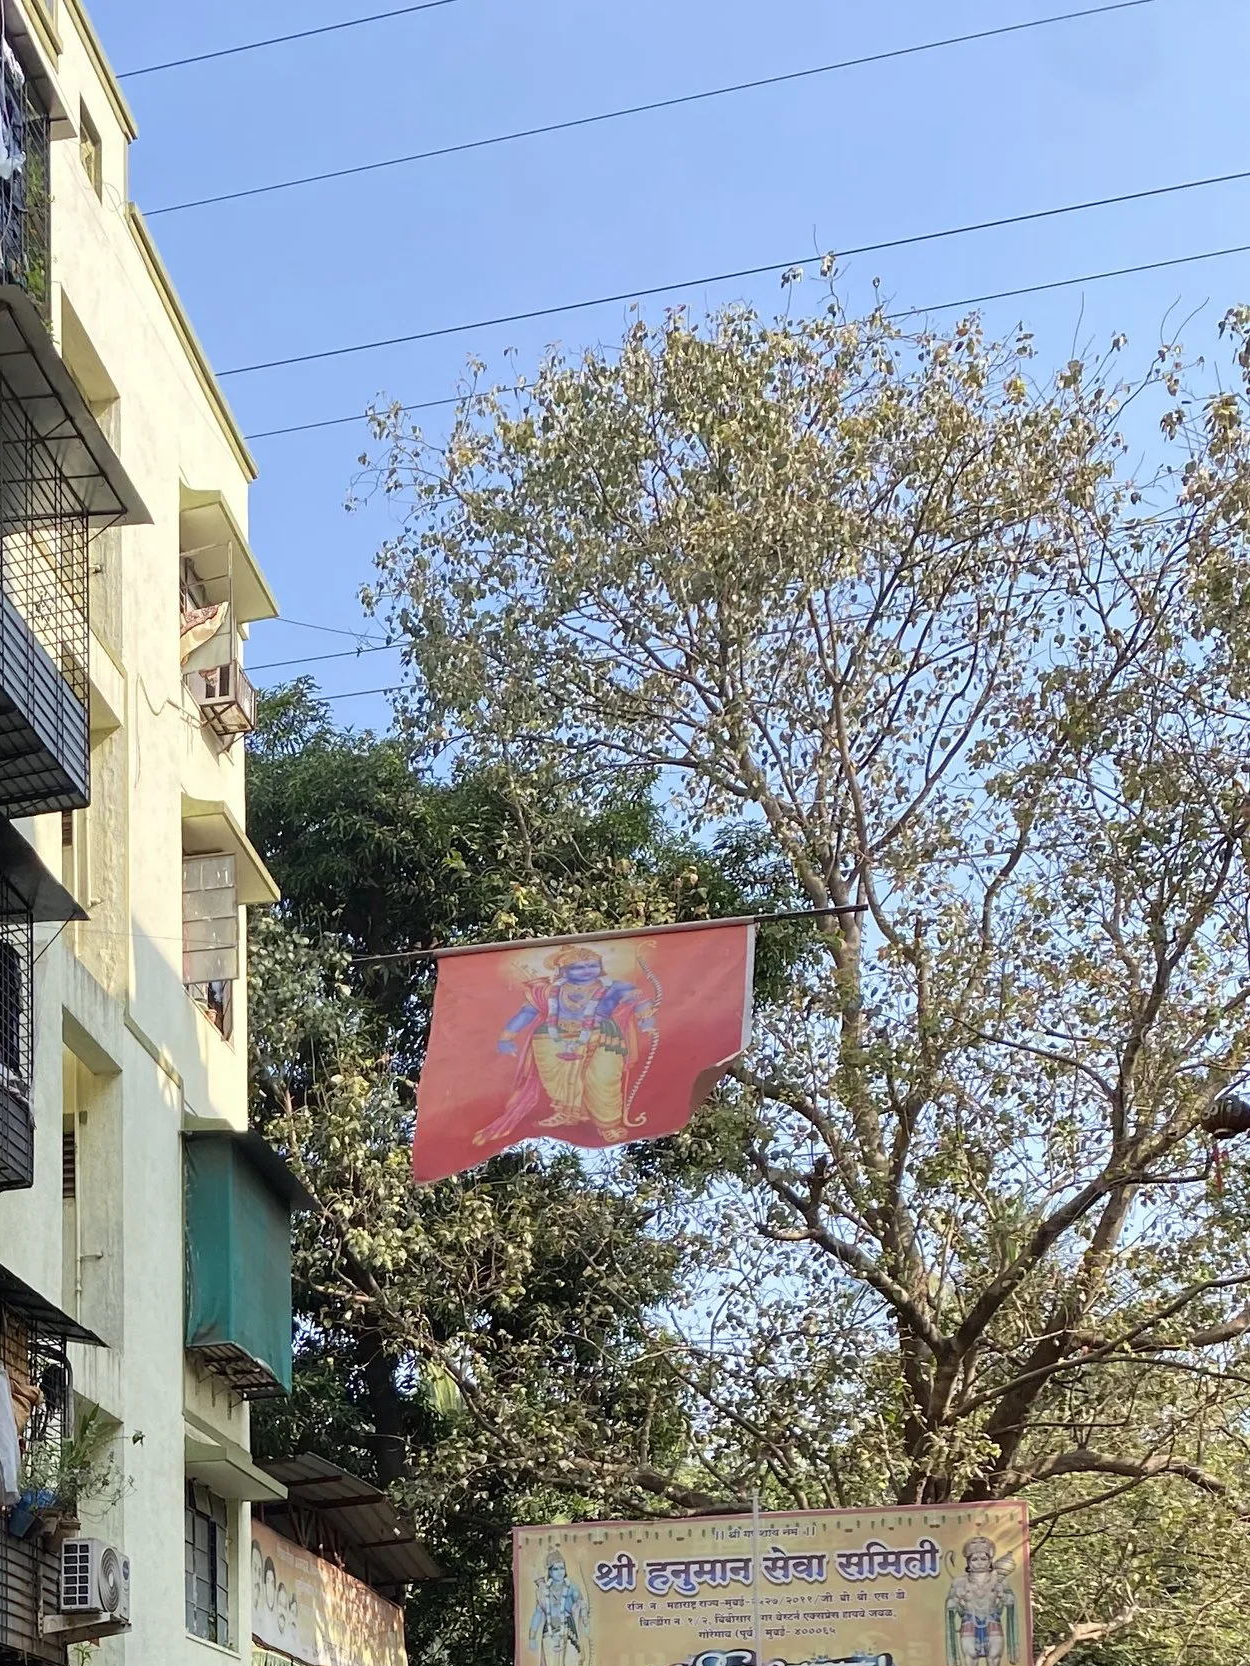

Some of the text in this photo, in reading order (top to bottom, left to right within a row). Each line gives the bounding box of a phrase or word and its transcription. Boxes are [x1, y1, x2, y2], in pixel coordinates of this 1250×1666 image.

[595, 1539, 940, 1592] श्री हनुमान सेवा समिती
